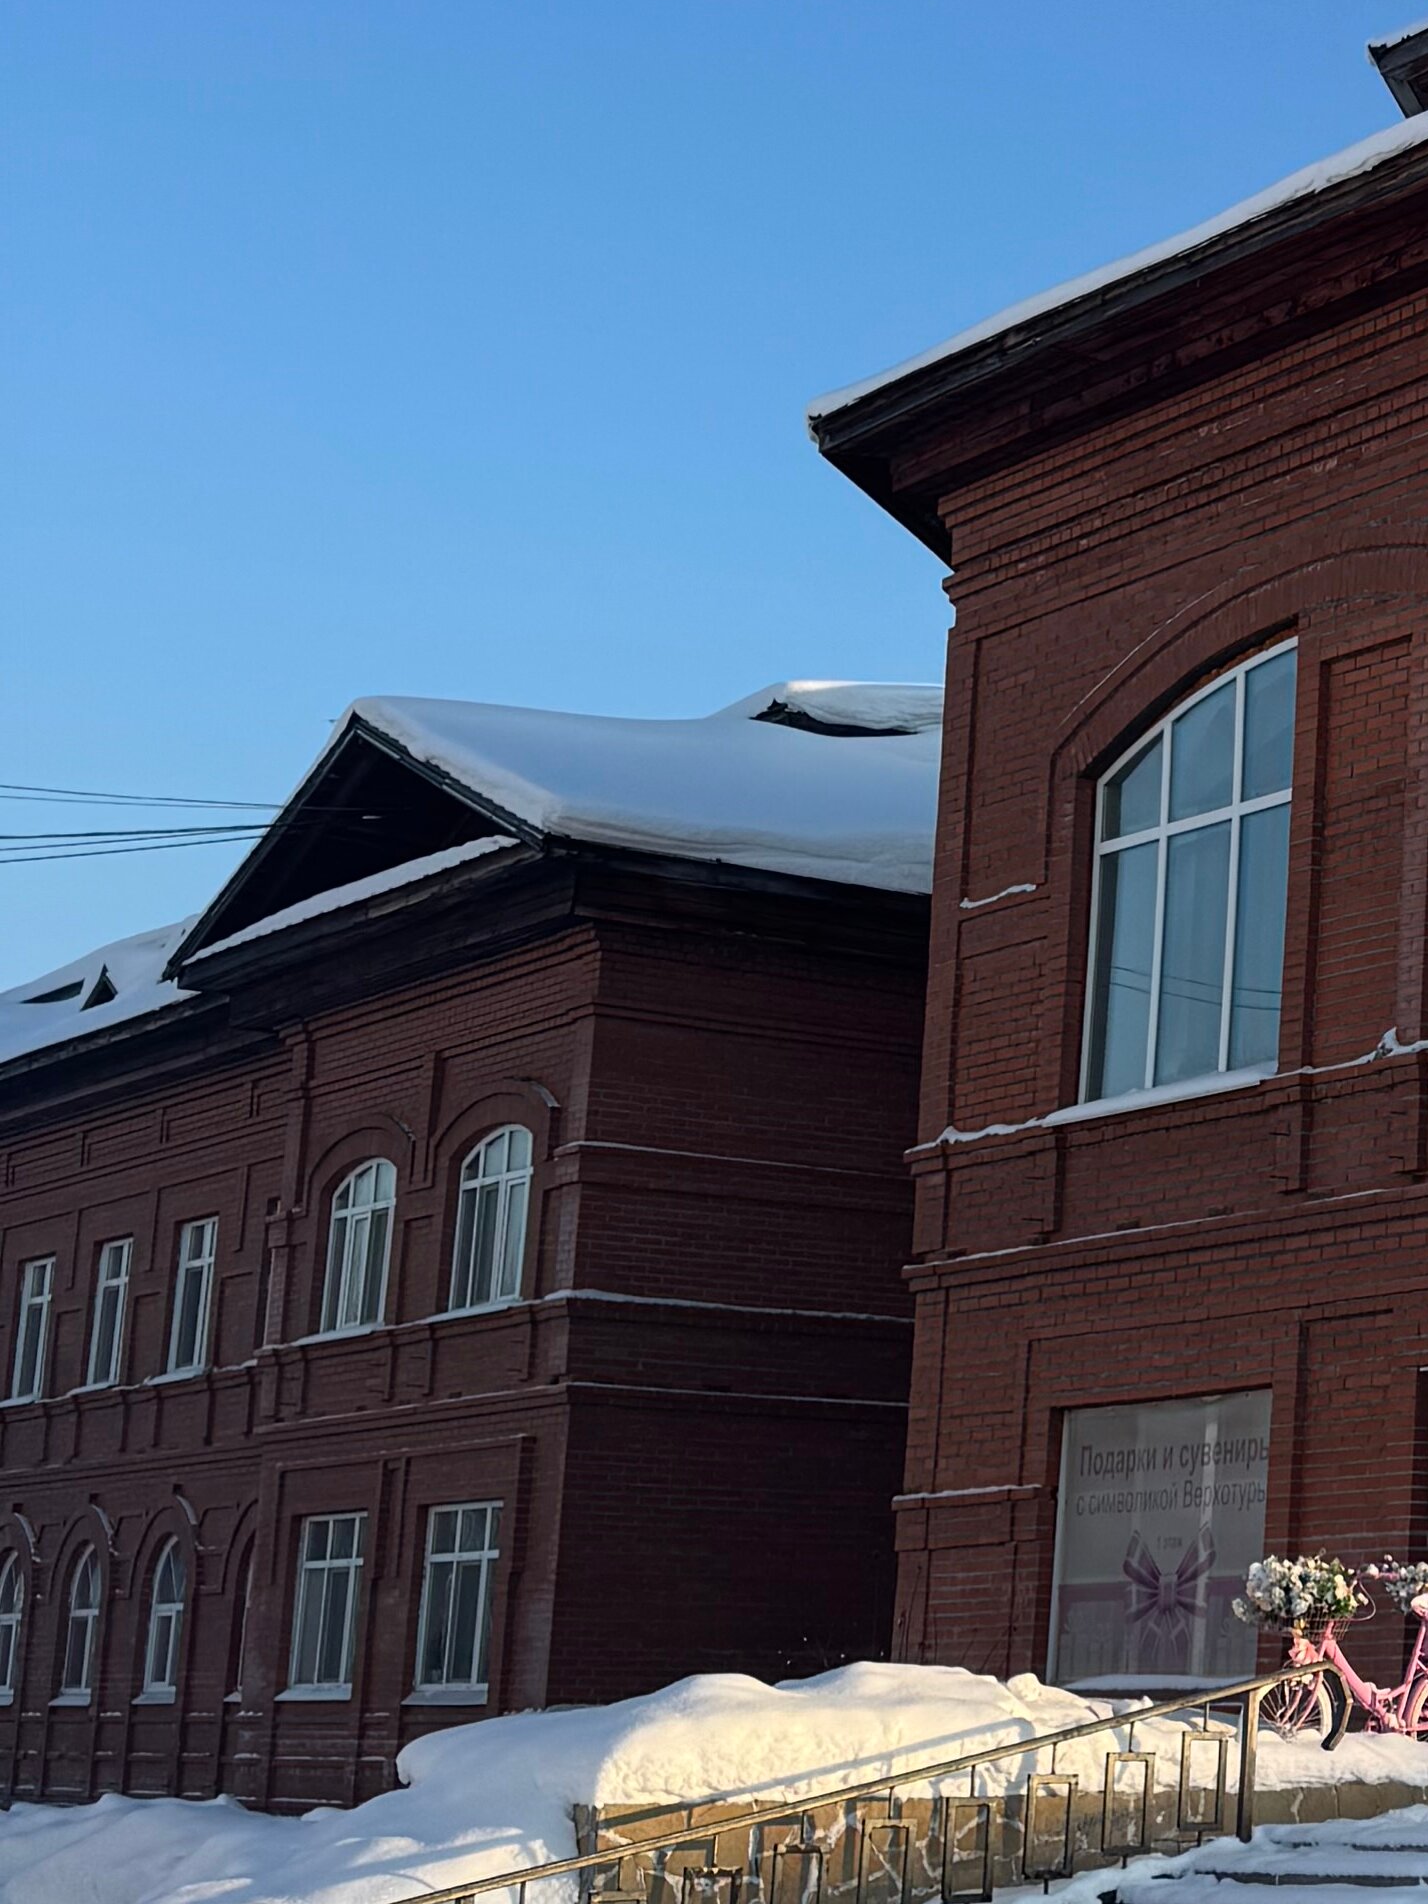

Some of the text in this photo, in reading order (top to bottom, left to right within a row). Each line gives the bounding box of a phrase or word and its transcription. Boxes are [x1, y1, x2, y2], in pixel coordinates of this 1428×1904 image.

[1079, 1445, 1157, 1480] Подарки
[1162, 1445, 1174, 1470] и
[1075, 1480, 1266, 1516] с символикой Верхотурь
